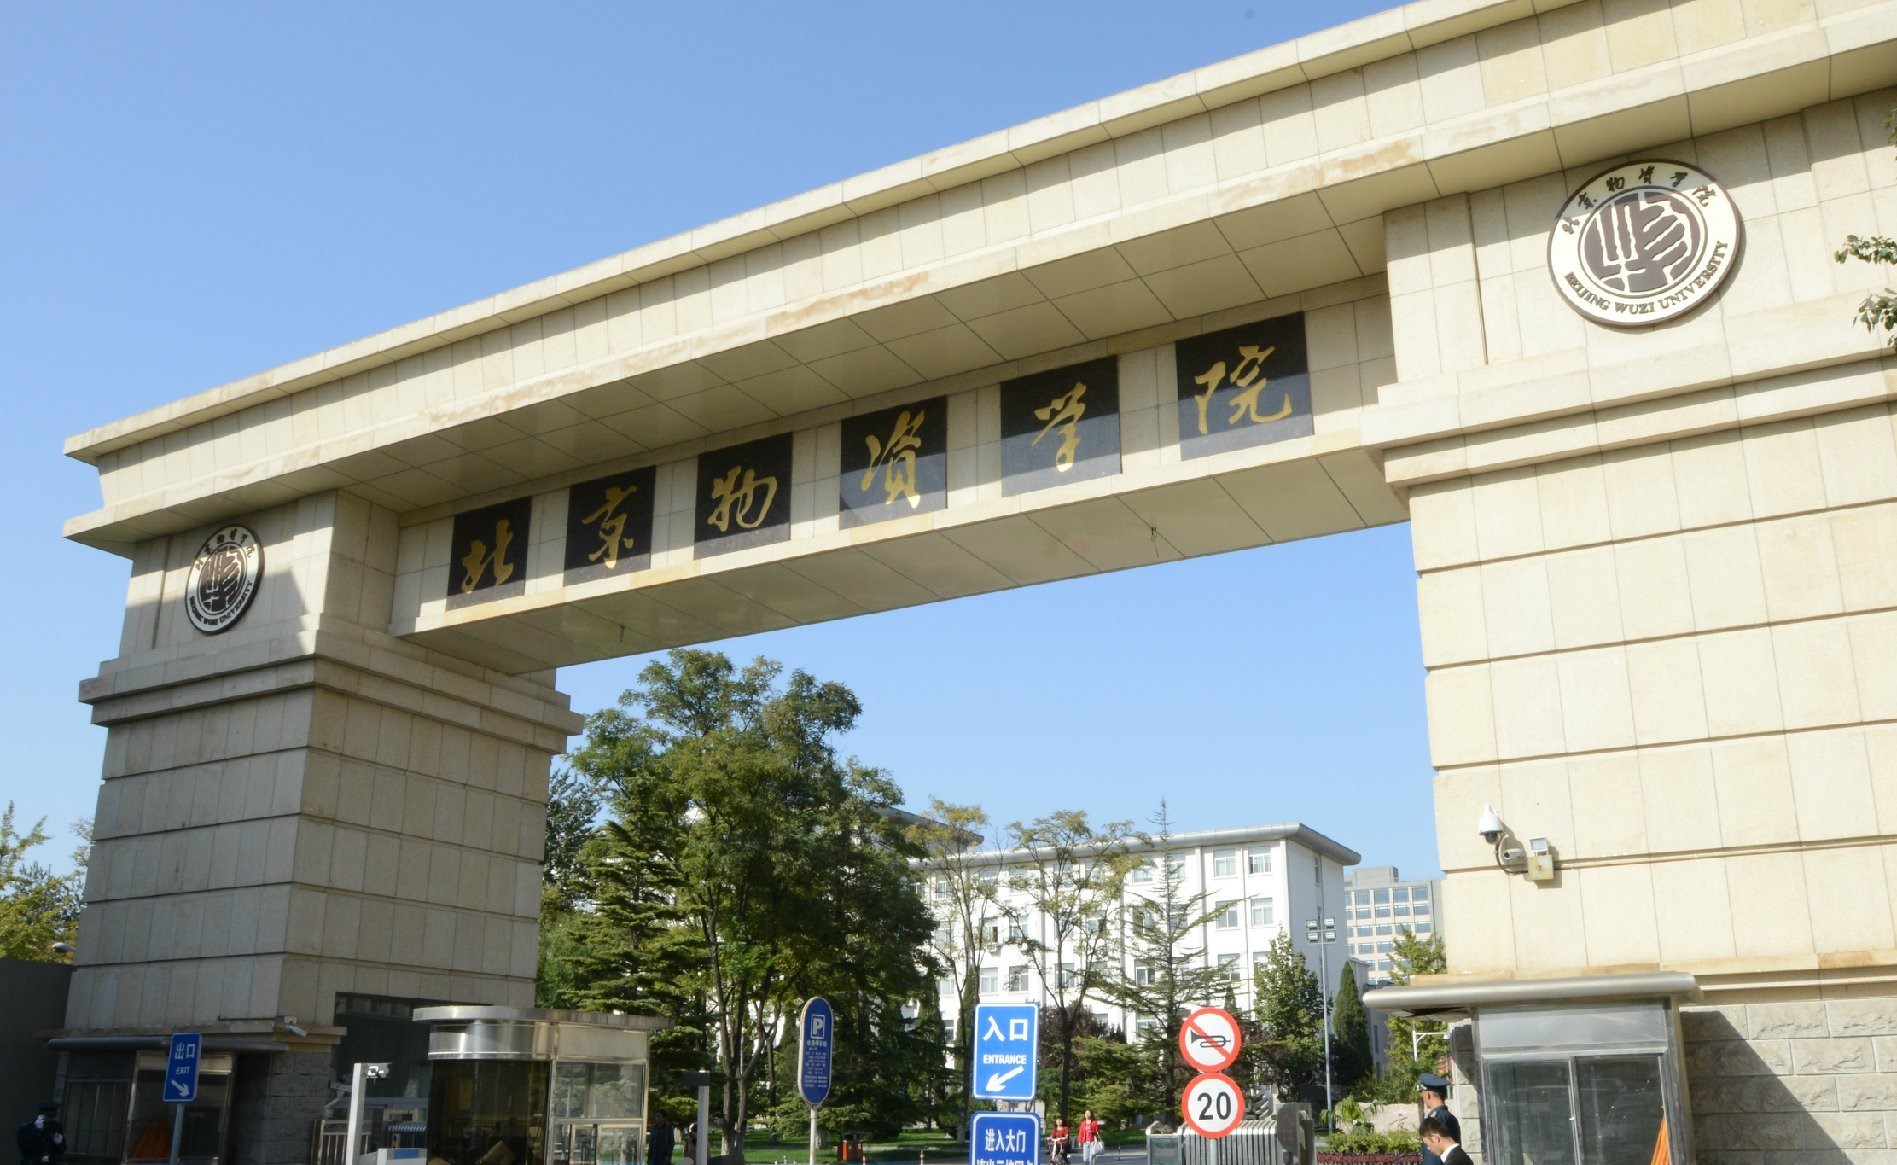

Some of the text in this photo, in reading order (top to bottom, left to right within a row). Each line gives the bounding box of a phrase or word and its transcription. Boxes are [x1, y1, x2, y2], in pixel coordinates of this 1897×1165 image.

[1564, 240, 1728, 315] BEIJING WUZI UNIVERSITY
[812, 1017, 824, 1035] P
[982, 1015, 1029, 1042] 入口
[174, 1042, 196, 1060] 出口
[982, 1054, 1027, 1065] ENTRANCE
[176, 1066, 190, 1074] EXIT
[1197, 1091, 1232, 1120] 20
[985, 1128, 1026, 1153] 进入大门
